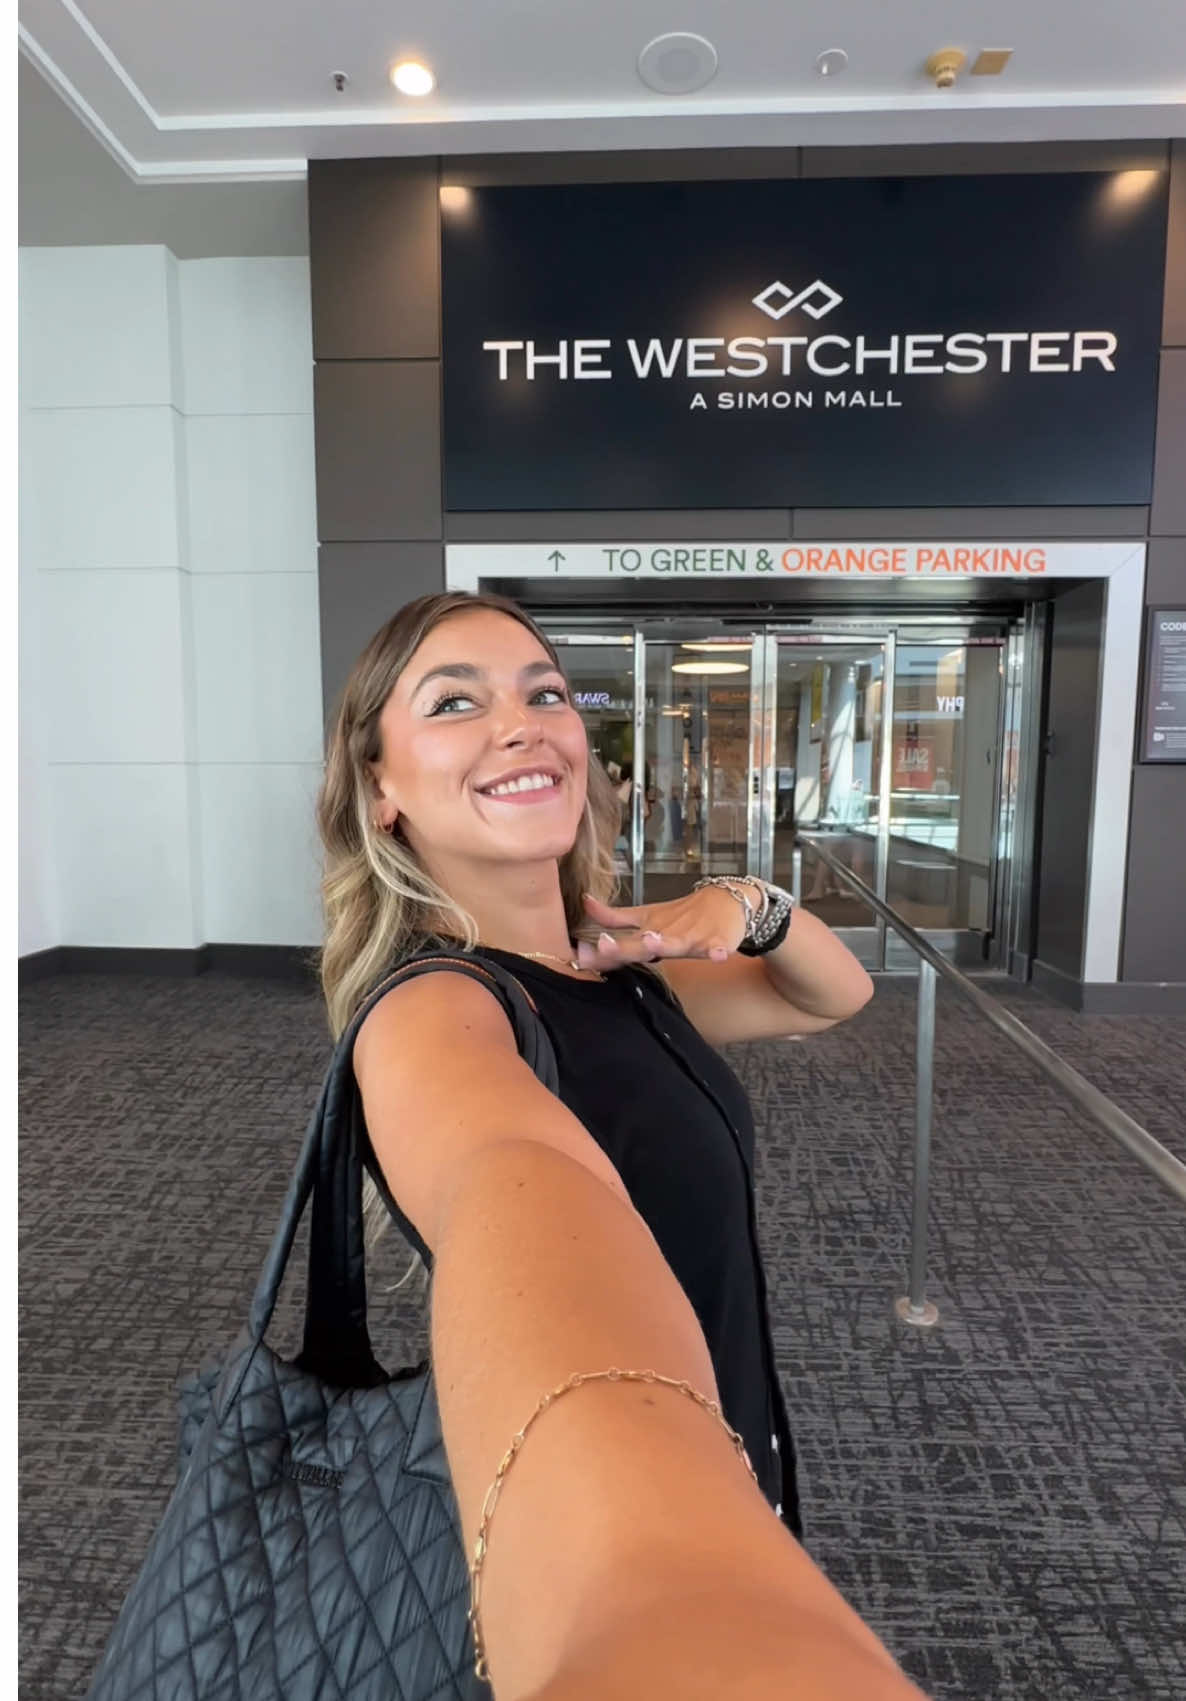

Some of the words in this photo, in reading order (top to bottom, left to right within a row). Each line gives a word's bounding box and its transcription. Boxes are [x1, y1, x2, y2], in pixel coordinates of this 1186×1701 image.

[483, 339, 611, 381] THE
[627, 331, 1118, 379] WESTCHESTER
[690, 392, 708, 410] A
[718, 391, 813, 410] SIMON
[825, 390, 903, 408] MALL
[603, 548, 642, 572] TO
[650, 548, 747, 572] GREEN
[756, 548, 774, 572] &
[782, 548, 905, 572] ORANGE
[917, 548, 1045, 572] PARKING
